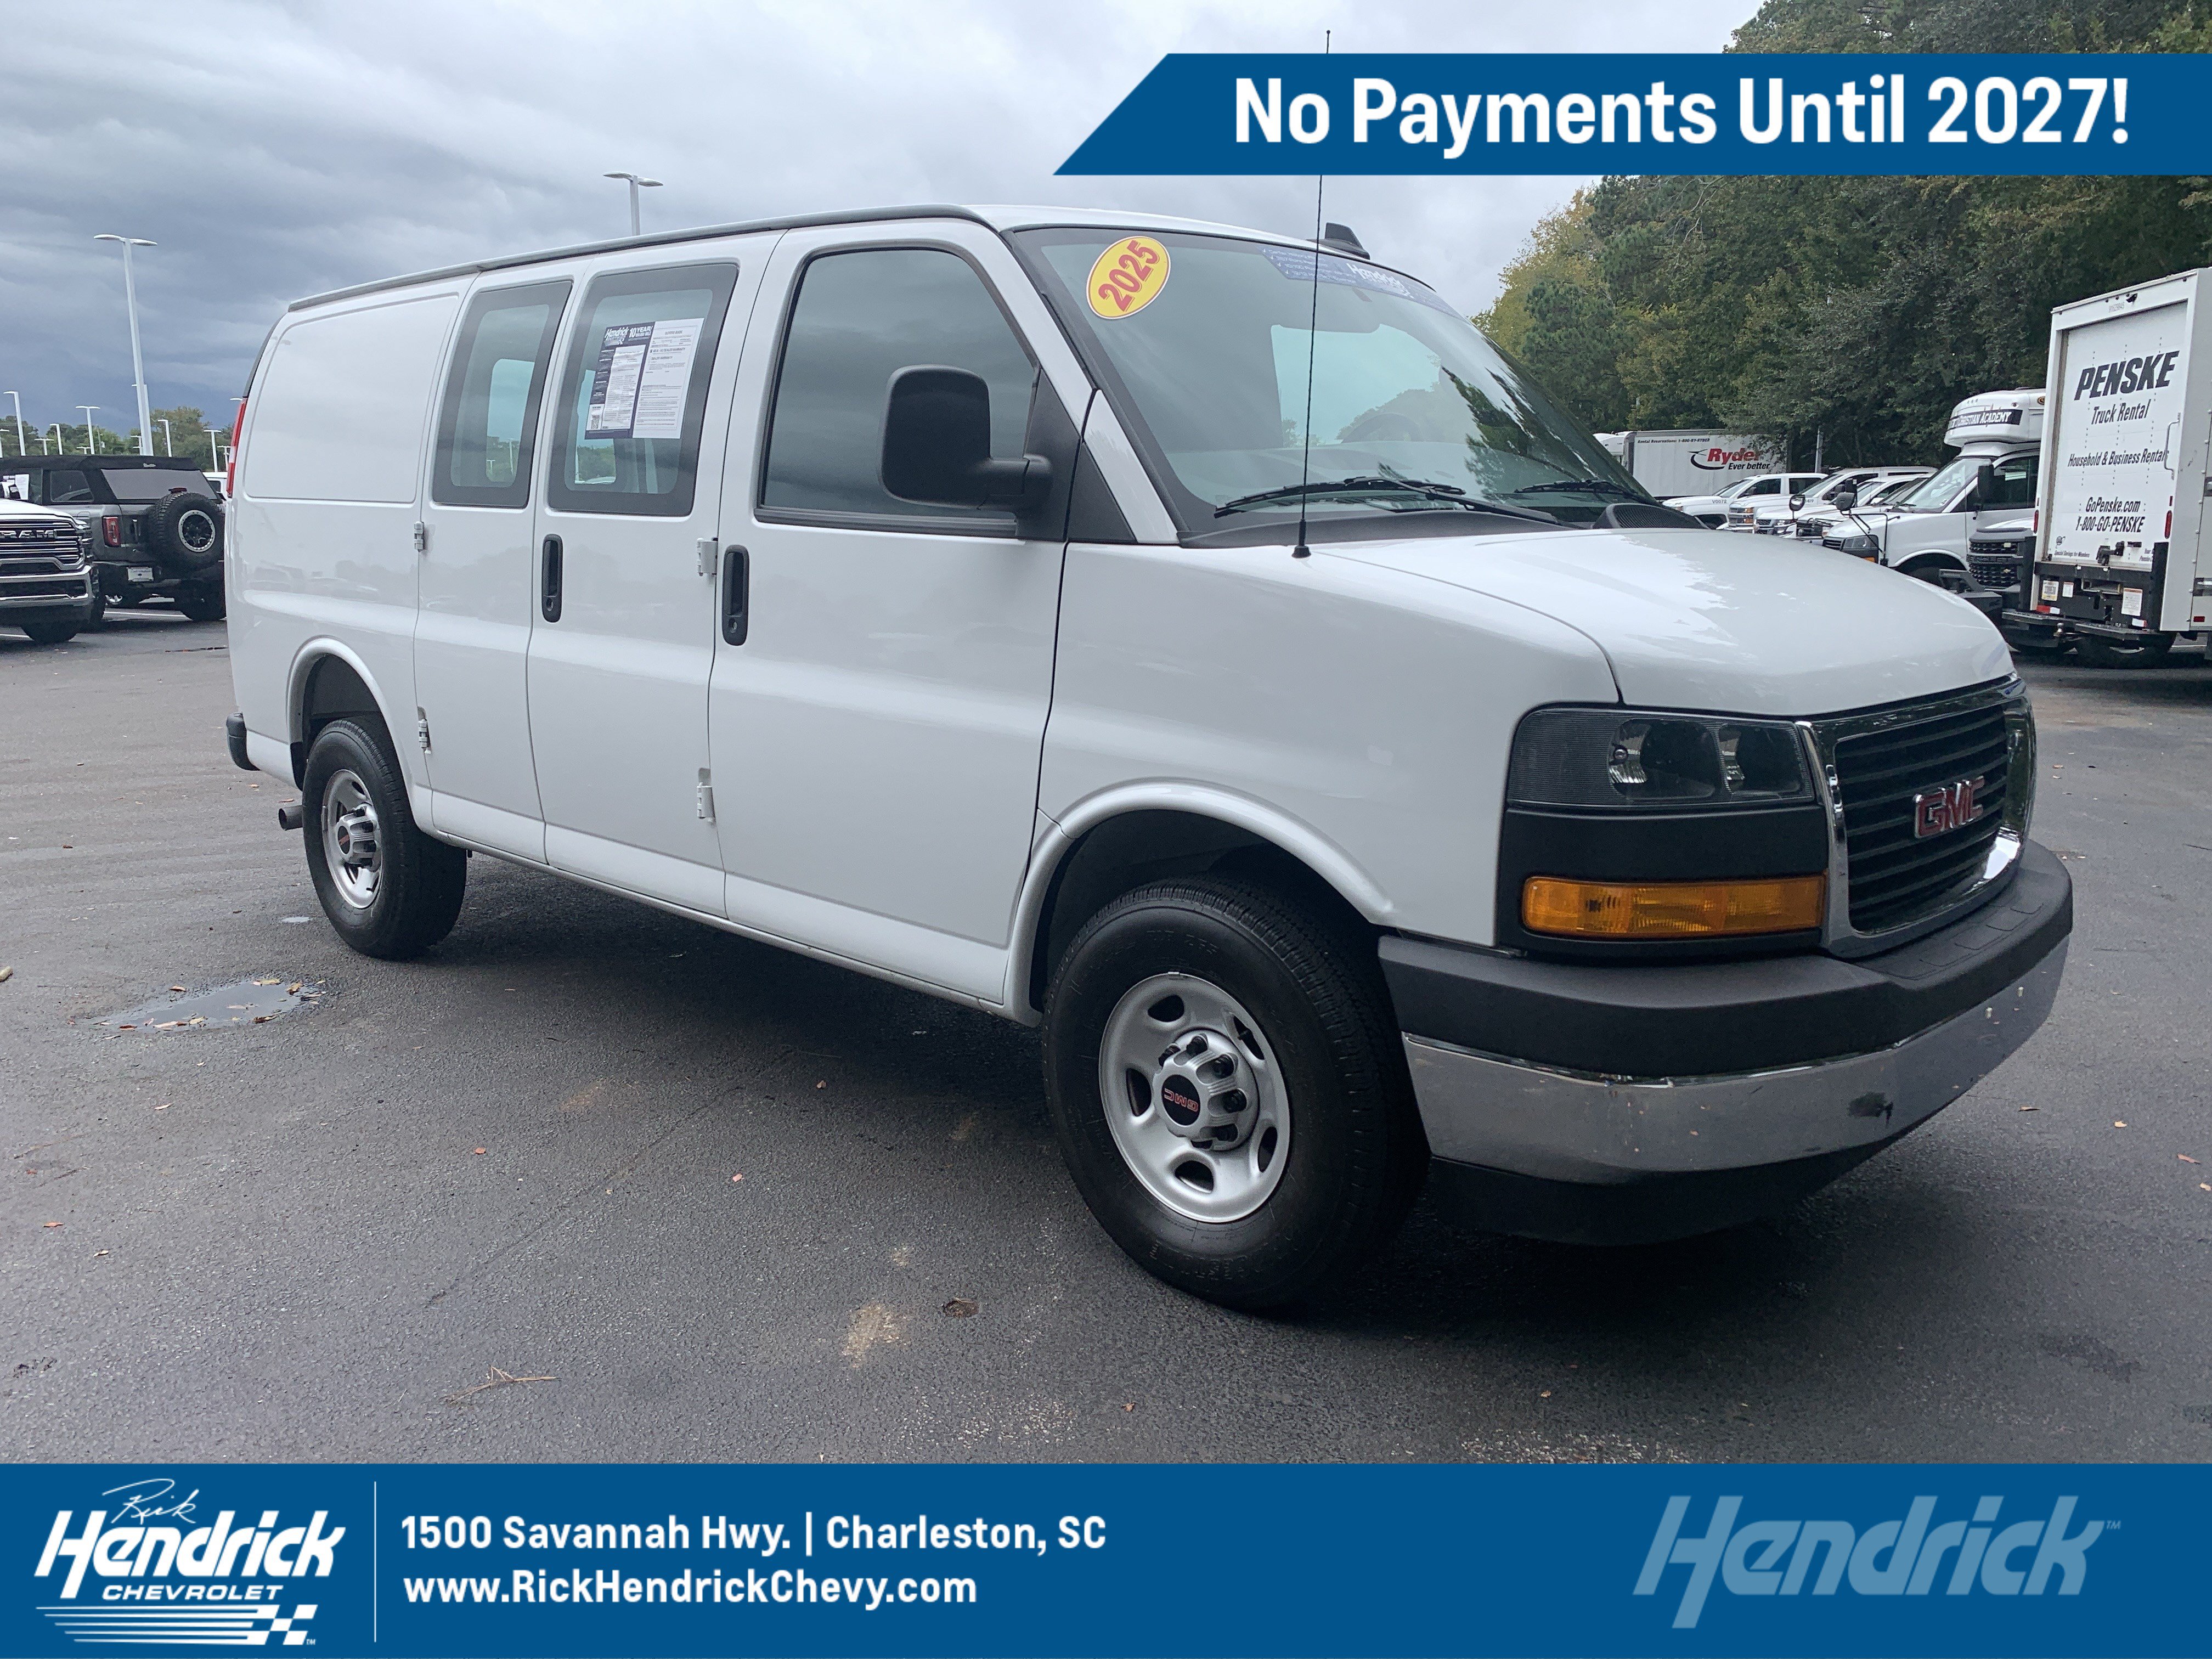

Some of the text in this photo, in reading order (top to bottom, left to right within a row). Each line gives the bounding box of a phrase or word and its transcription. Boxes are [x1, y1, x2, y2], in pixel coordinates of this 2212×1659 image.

[1098, 240, 1160, 312] 2025
[629, 328, 636, 338] 10
[2074, 350, 2180, 401] PENSKE
[1979, 411, 2012, 424] ACADEMY
[2091, 399, 2152, 425] Truck Rental
[1707, 448, 1760, 465] Ryder
[2067, 452, 2103, 467] Household
[2101, 451, 2109, 466] &
[2108, 450, 2141, 465] Business
[2086, 496, 2141, 512] GoPenske.com
[2075, 515, 2146, 533] 1-800-GO-PENSKE
[0, 530, 54, 538] RAM
[1912, 775, 1986, 839] GMC
[1163, 1087, 1199, 1113] GMC
